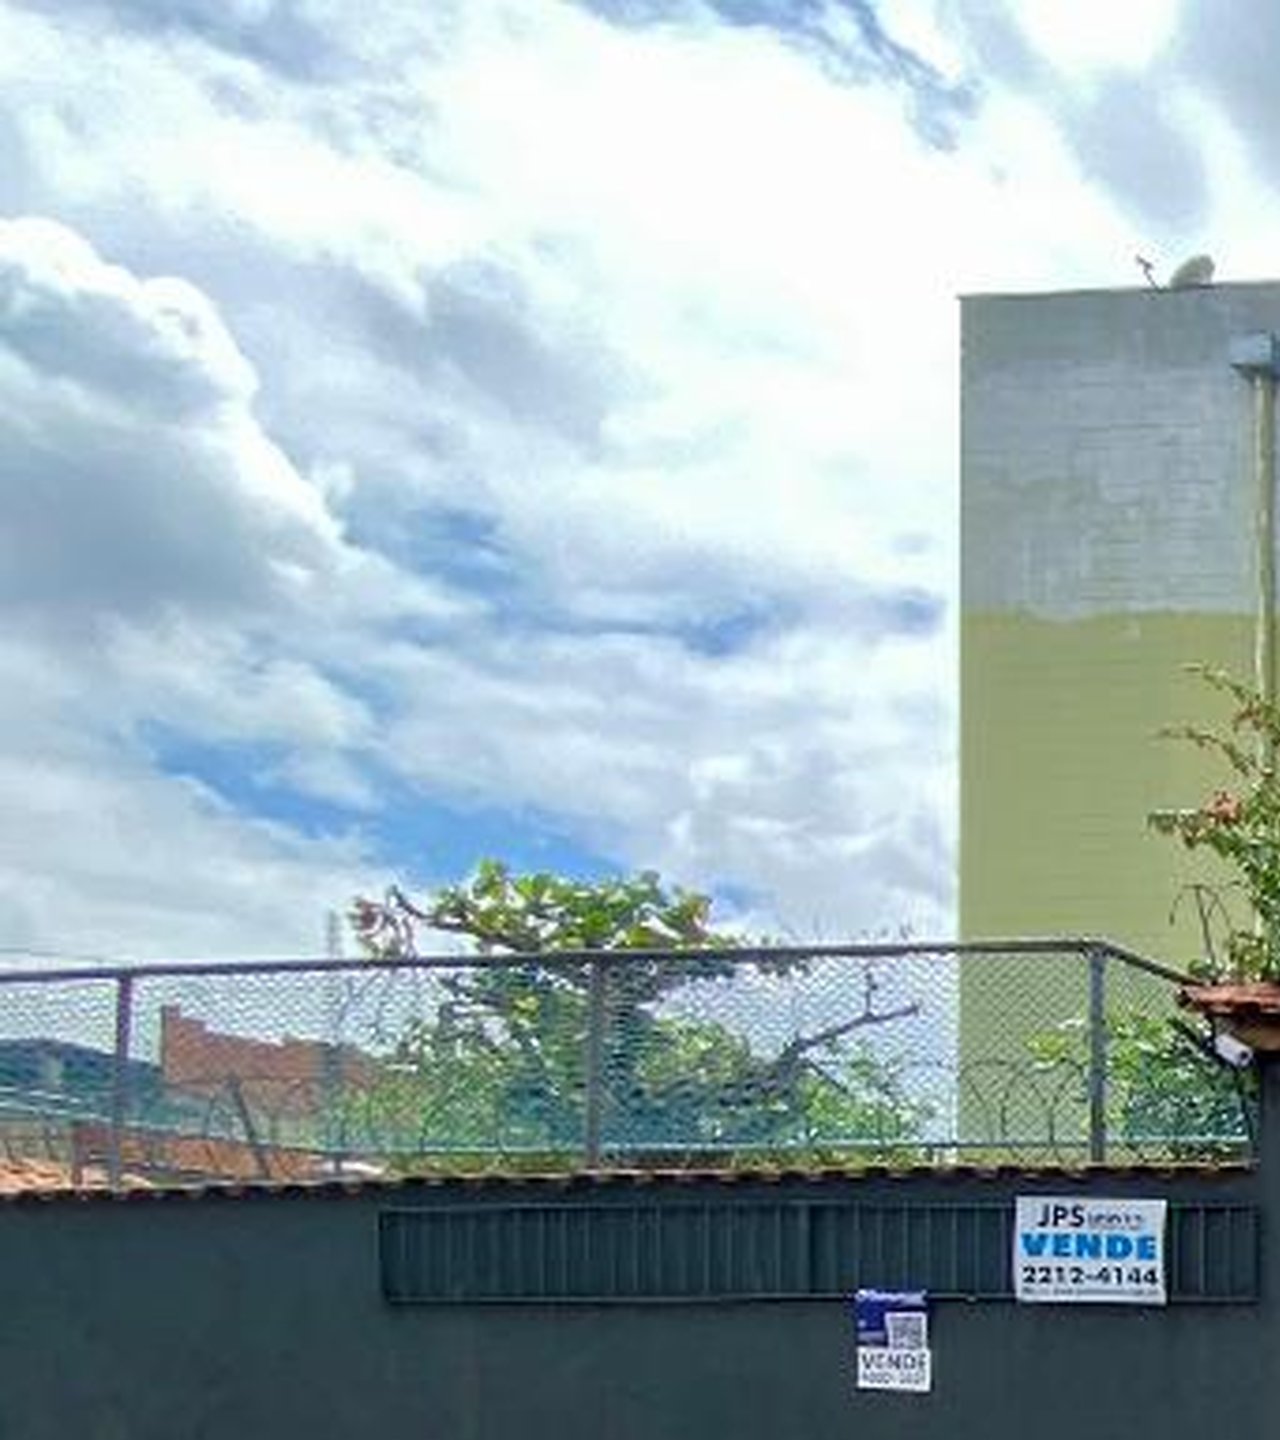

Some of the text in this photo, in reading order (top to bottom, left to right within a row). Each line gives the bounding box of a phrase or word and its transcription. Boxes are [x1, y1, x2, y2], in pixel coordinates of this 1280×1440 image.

[1037, 1204, 1085, 1228] JPS
[1021, 1233, 1157, 1261] VENDE
[1022, 1265, 1158, 1285] 2212-4144
[861, 1353, 927, 1370] VENDE
